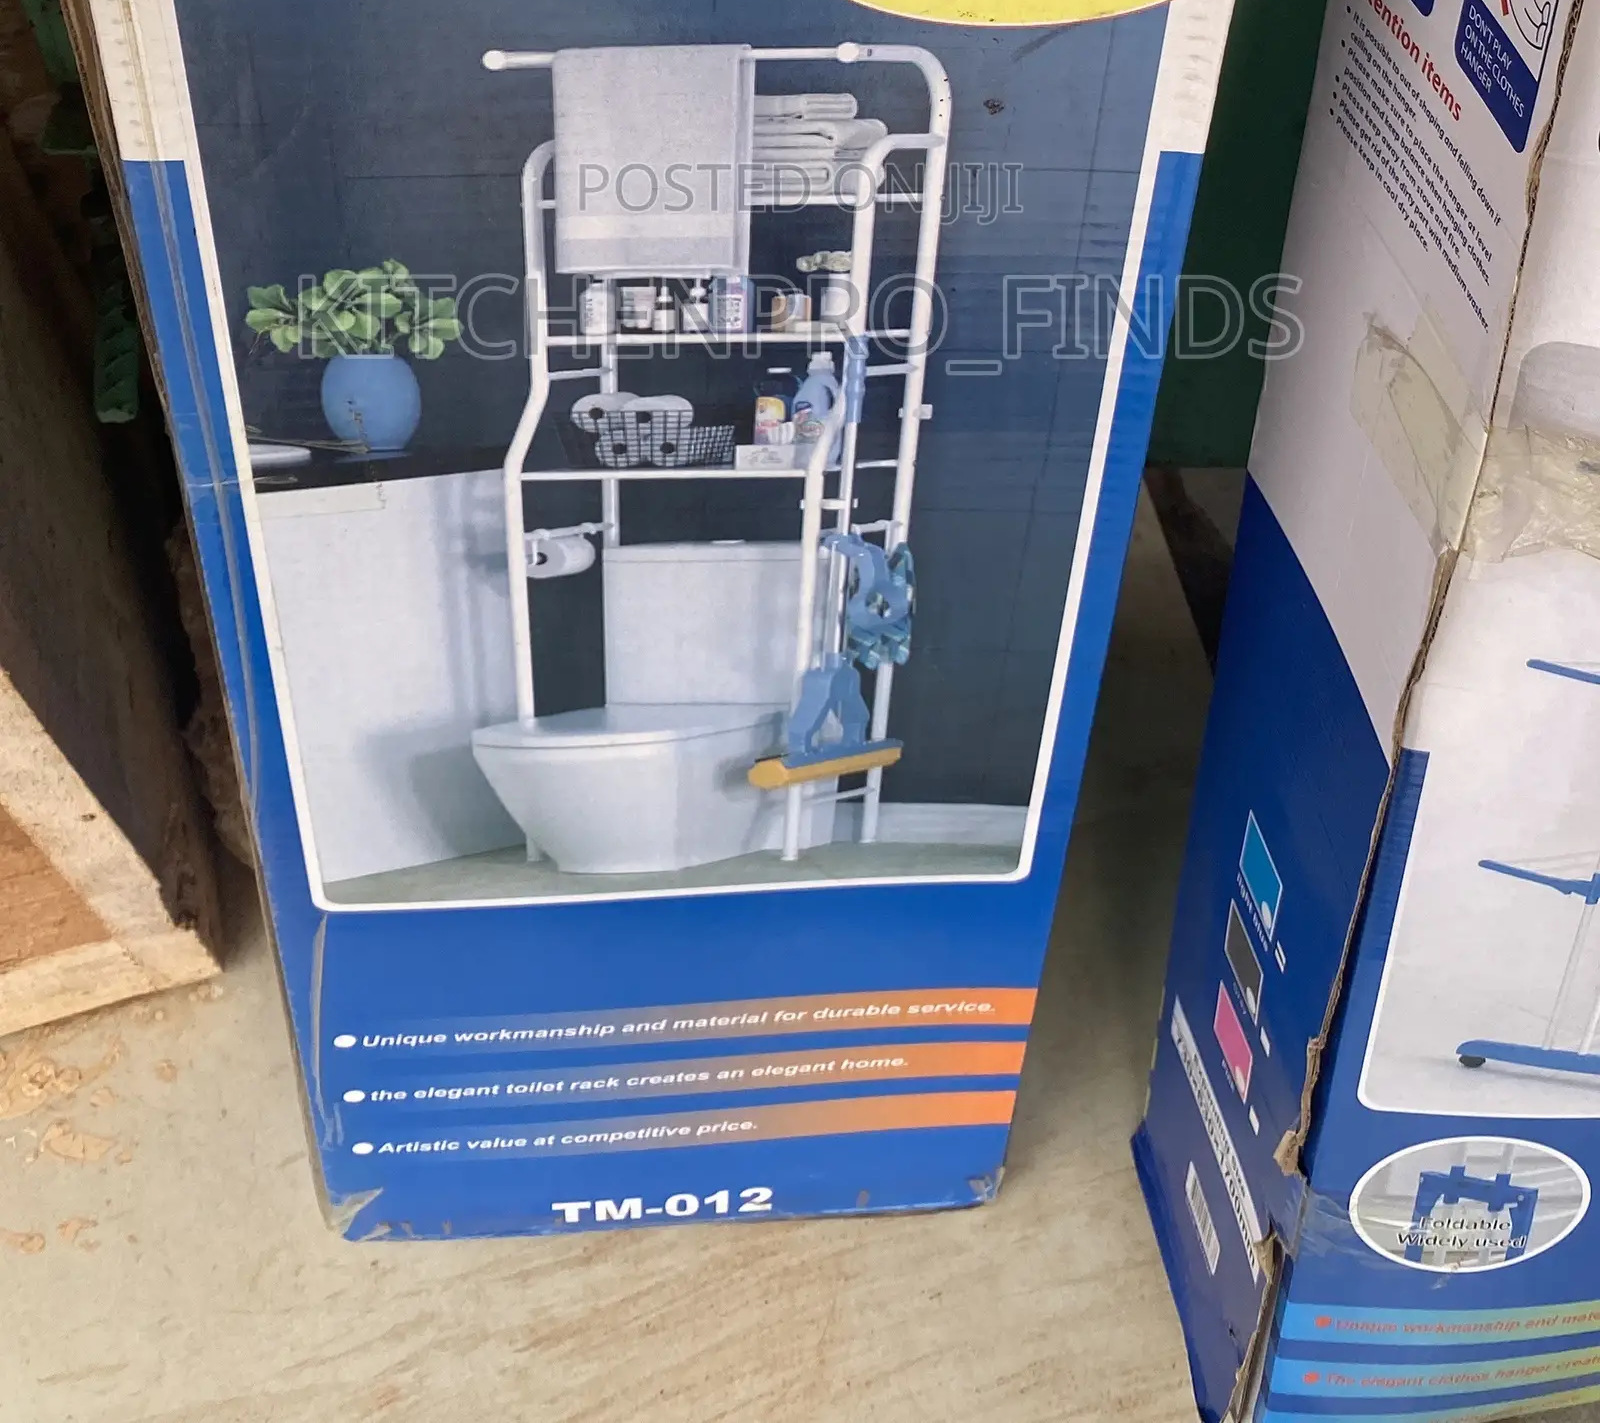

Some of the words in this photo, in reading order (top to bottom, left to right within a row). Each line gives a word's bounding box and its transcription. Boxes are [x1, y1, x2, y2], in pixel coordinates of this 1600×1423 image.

[1421, 52, 1462, 122] items
[1460, 41, 1492, 94] HANGER
[1465, 24, 1478, 48] ON
[1478, 39, 1493, 70] THE
[1492, 63, 1525, 118] CLOTHES
[1492, 38, 1513, 71] PLAY
[1372, 59, 1381, 74] on
[1381, 69, 1393, 89] the
[1392, 82, 1417, 123] hanger.
[1344, 66, 1371, 103] position
[1371, 101, 1386, 121] and
[1384, 115, 1400, 142] keep
[1400, 137, 1425, 178] balance
[1425, 174, 1442, 204] when
[1442, 199, 1468, 247] hanging
[1365, 28, 1392, 66] possible
[1392, 58, 1400, 75] to
[1400, 73, 1412, 92] out
[1411, 88, 1420, 101] of
[1419, 98, 1445, 140] shaping
[1444, 136, 1459, 158] and
[1476, 187, 1495, 218] down
[1494, 212, 1501, 227] if
[1358, 144, 1375, 172] keep
[1374, 167, 1383, 183] in
[1382, 180, 1398, 203] cool
[1397, 201, 1410, 221] dry
[1364, 110, 1381, 137] keep
[1381, 136, 1400, 163] away
[1400, 159, 1416, 187] from
[1416, 185, 1434, 215] stove
[1434, 213, 1448, 236] and
[1370, 78, 1390, 106] make
[1390, 103, 1405, 127] sure
[1405, 123, 1413, 138] to
[1413, 136, 1432, 166] place
[1432, 162, 1444, 184] the
[1443, 180, 1468, 221] hanger
[1467, 221, 1476, 236] at
[1475, 231, 1493, 263] level
[1359, 128, 1372, 145] get
[1371, 142, 1382, 158] rid
[1381, 156, 1390, 168] of
[1388, 165, 1400, 185] the
[1399, 182, 1415, 207] dirty
[1414, 204, 1429, 230] part
[1428, 225, 1442, 251] with
[1442, 249, 1467, 292] medium
[362, 1031, 448, 1049] Unique
[453, 1023, 616, 1044] workmanship
[621, 1019, 668, 1034] and
[671, 1010, 768, 1030] material
[772, 1008, 805, 1024] for
[813, 1002, 901, 1020] durable
[906, 999, 996, 1016] service.
[370, 1087, 407, 1102] the
[413, 1083, 500, 1103] elegant
[505, 1079, 565, 1095] toilet
[569, 1075, 620, 1091] rack
[626, 1071, 710, 1088] creates
[716, 1068, 745, 1081] an
[751, 1060, 836, 1080] elegant
[840, 1055, 910, 1070] home.
[378, 1138, 460, 1154] Artistic
[466, 1135, 528, 1151] value
[533, 1134, 555, 1147] at
[560, 1125, 691, 1145] competitive
[696, 1118, 758, 1135] price.
[551, 1186, 774, 1224] TM-012
[1396, 1233, 1468, 1248] Widely
[1474, 1234, 1527, 1248] used
